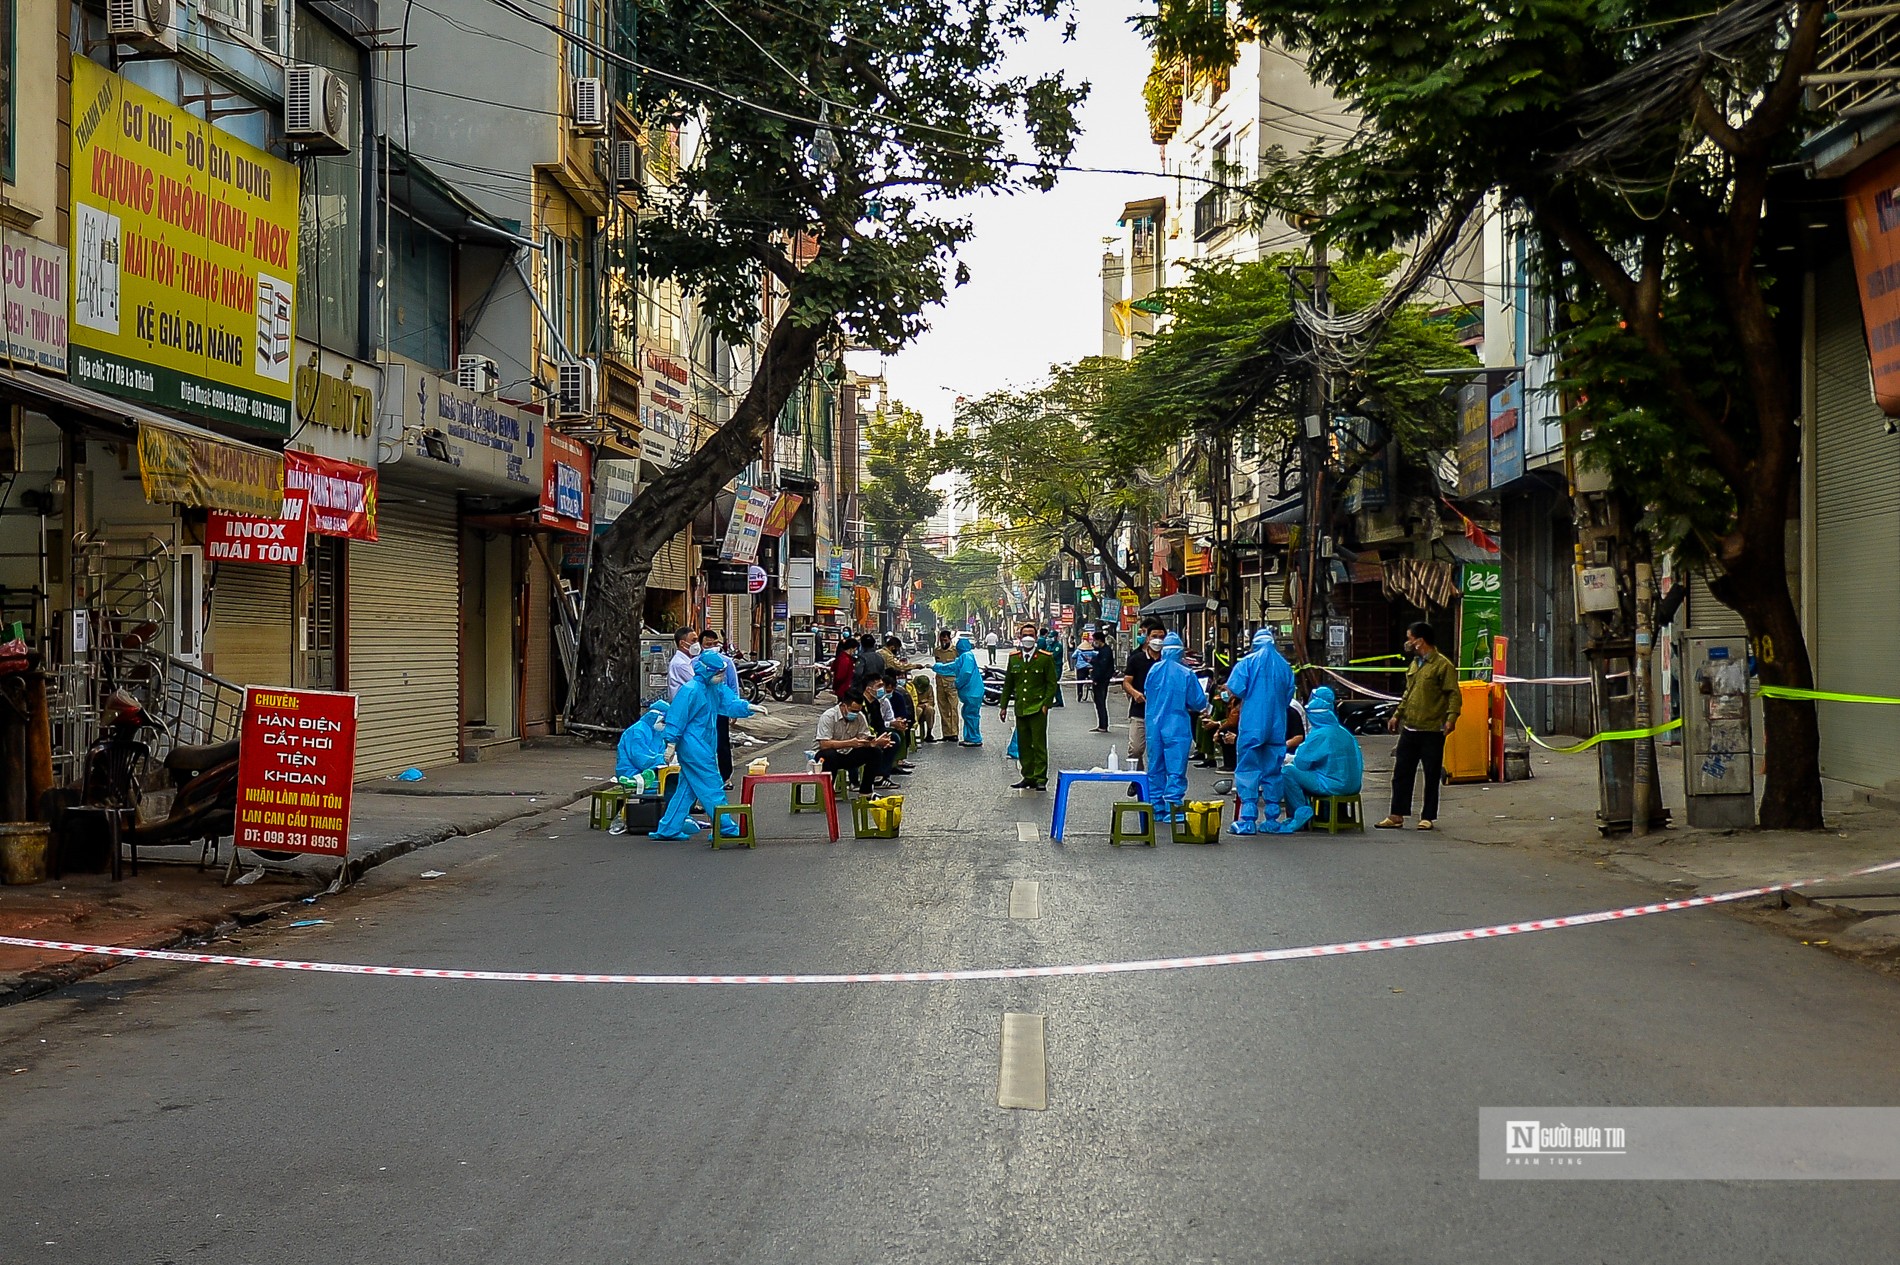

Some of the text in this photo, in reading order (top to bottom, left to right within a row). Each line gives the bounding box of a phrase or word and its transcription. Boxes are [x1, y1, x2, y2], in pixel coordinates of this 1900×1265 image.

[75, 99, 101, 153] THÀNH
[123, 100, 144, 143] CƠ
[148, 114, 172, 157] KHÍ
[186, 123, 205, 172] ĐỒ
[209, 143, 232, 185] GIA
[236, 155, 272, 203] DỤNG
[91, 145, 155, 214] KHUNG
[158, 174, 207, 238] NHÔM
[209, 188, 248, 254] KÍNH
[253, 216, 291, 271] INOX
[2, 244, 61, 302] CƠ KHÍ
[124, 222, 148, 278] MÁI
[151, 231, 176, 288] TÔN
[181, 251, 219, 303] THANG
[221, 263, 254, 315] NHÔM
[7, 300, 24, 336] BEN
[31, 301, 51, 344] THỦY
[136, 301, 243, 367] KỆ GIÁ ĐA NĂNG
[106, 362, 115, 383] 77
[125, 367, 134, 388] La
[353, 384, 373, 439] 79
[225, 521, 286, 540] INOX
[209, 540, 299, 563] MÁI TÔN
[255, 693, 300, 709] CHUYÊN:
[257, 712, 342, 734] HÀN ĐIỆN
[263, 730, 333, 750] CẮT HƠI
[276, 751, 317, 768] TIỆN
[264, 769, 327, 786] KHOAN
[245, 787, 343, 810] NHẬN LÀM MÁI TÔN
[242, 809, 262, 824] LAN
[263, 811, 285, 827] CAN
[310, 814, 343, 831] THANG
[244, 828, 339, 850] ĐT: 098 331 8936
